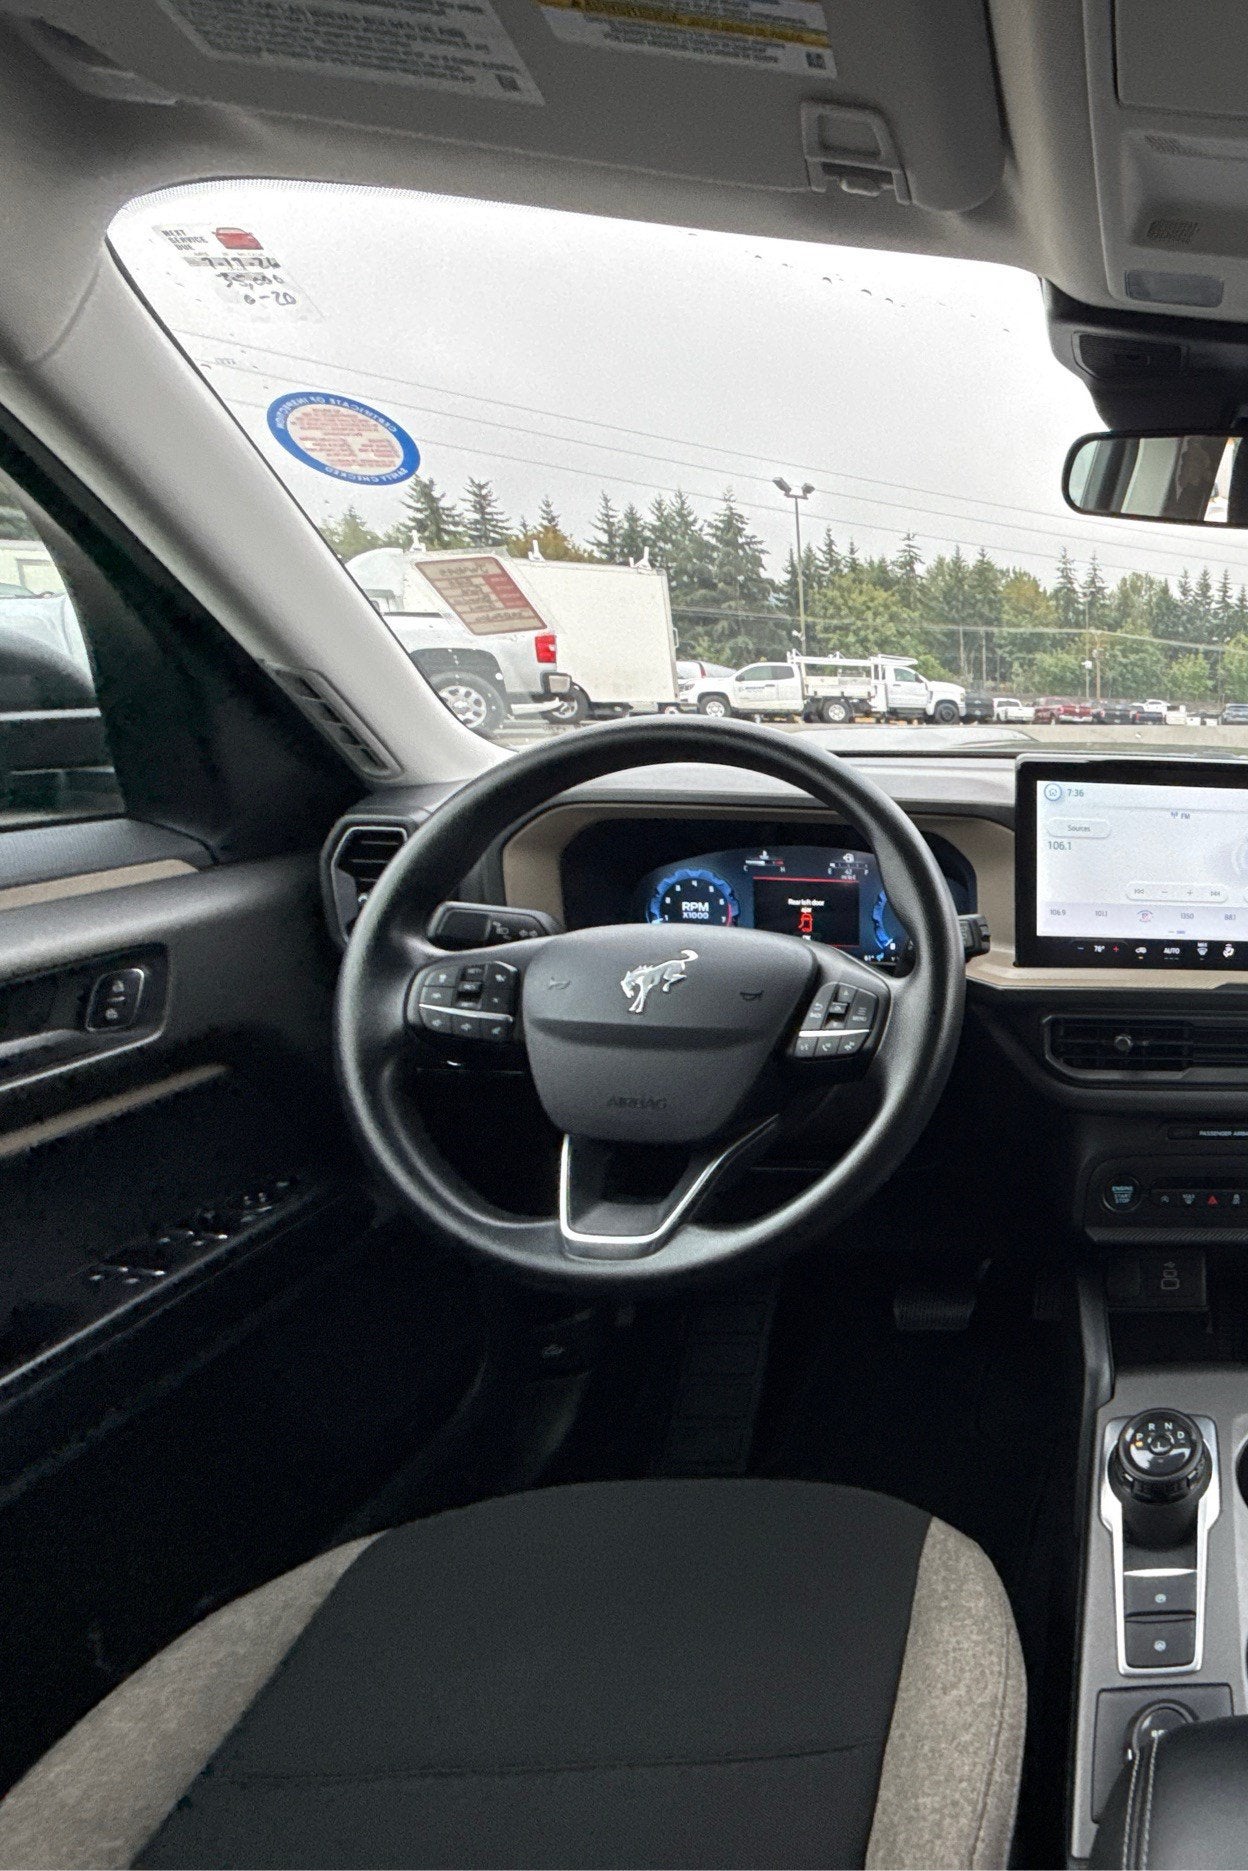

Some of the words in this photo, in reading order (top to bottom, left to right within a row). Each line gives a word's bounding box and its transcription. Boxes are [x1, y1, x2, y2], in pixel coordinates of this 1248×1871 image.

[161, 229, 187, 237] NEXT
[167, 236, 209, 244] SERVICE
[174, 243, 195, 251] DUE
[1067, 824, 1091, 833] Sources
[1047, 840, 1073, 851] 106.1
[681, 901, 710, 912] RPM
[1050, 909, 1066, 917] 106.9
[1163, 947, 1181, 955] AUTO
[1148, 1422, 1156, 1431] R
[1164, 1422, 1173, 1430] N
[1176, 1430, 1185, 1439] D
